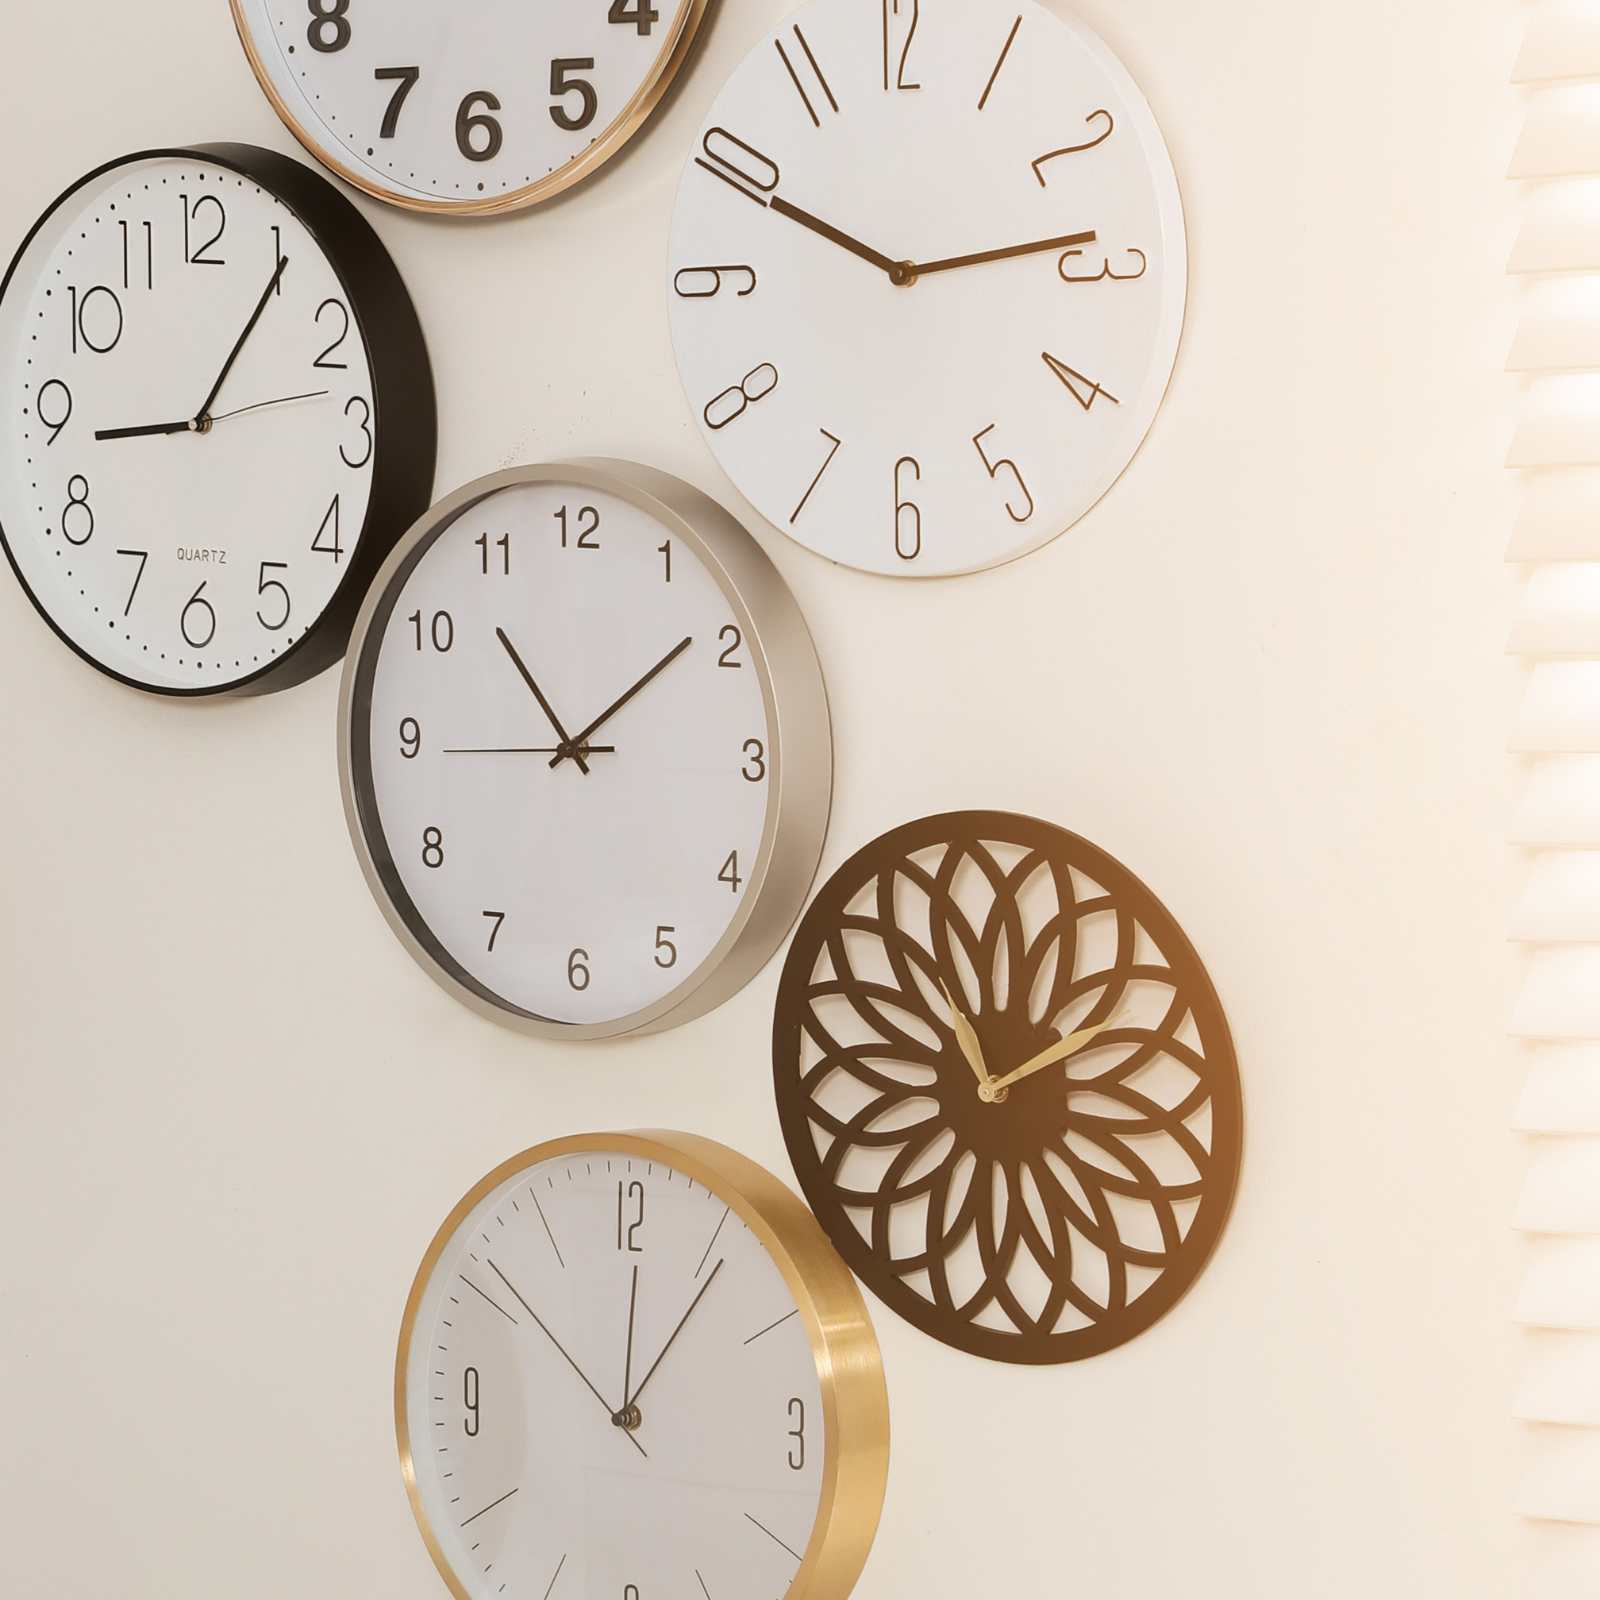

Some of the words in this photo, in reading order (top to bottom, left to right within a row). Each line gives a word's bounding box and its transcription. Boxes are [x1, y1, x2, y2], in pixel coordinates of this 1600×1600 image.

[306, 0, 352, 54] 8
[882, 0, 921, 91] 12
[374, 65, 420, 139] 7
[454, 90, 503, 163] 6
[548, 56, 598, 132] 5
[694, 126, 781, 208] 10
[1030, 109, 1114, 188] 2
[117, 219, 153, 291] 11
[178, 193, 226, 266] 12
[270, 225, 281, 296] 1
[673, 264, 757, 298] 9
[1057, 247, 1147, 284] 3
[66, 285, 124, 354] 10
[312, 297, 349, 370] 2
[36, 378, 73, 447] 9
[703, 362, 779, 430] 8
[1041, 351, 1120, 411] 4
[338, 395, 373, 469] 3
[789, 427, 842, 525] 7
[972, 423, 1034, 523] 5
[61, 473, 95, 546] 8
[310, 493, 345, 564] 4
[553, 504, 600, 550] 12
[894, 456, 921, 561] 6
[116, 549, 149, 617] 7
[177, 547, 227, 565] QUARTZ
[474, 531, 510, 576] 11
[657, 539, 671, 583] 1
[180, 580, 216, 649] 6
[256, 561, 291, 631] 5
[408, 609, 454, 653] 10
[717, 624, 742, 669] 2
[399, 716, 421, 760] 9
[741, 738, 766, 783] 3
[421, 826, 444, 869] 8
[717, 849, 743, 893] 4
[482, 910, 506, 952] 7
[654, 925, 677, 969] 5
[567, 947, 590, 992] 6
[617, 1180, 644, 1252] 12
[463, 1366, 480, 1437] 9
[787, 1397, 805, 1471] 3
